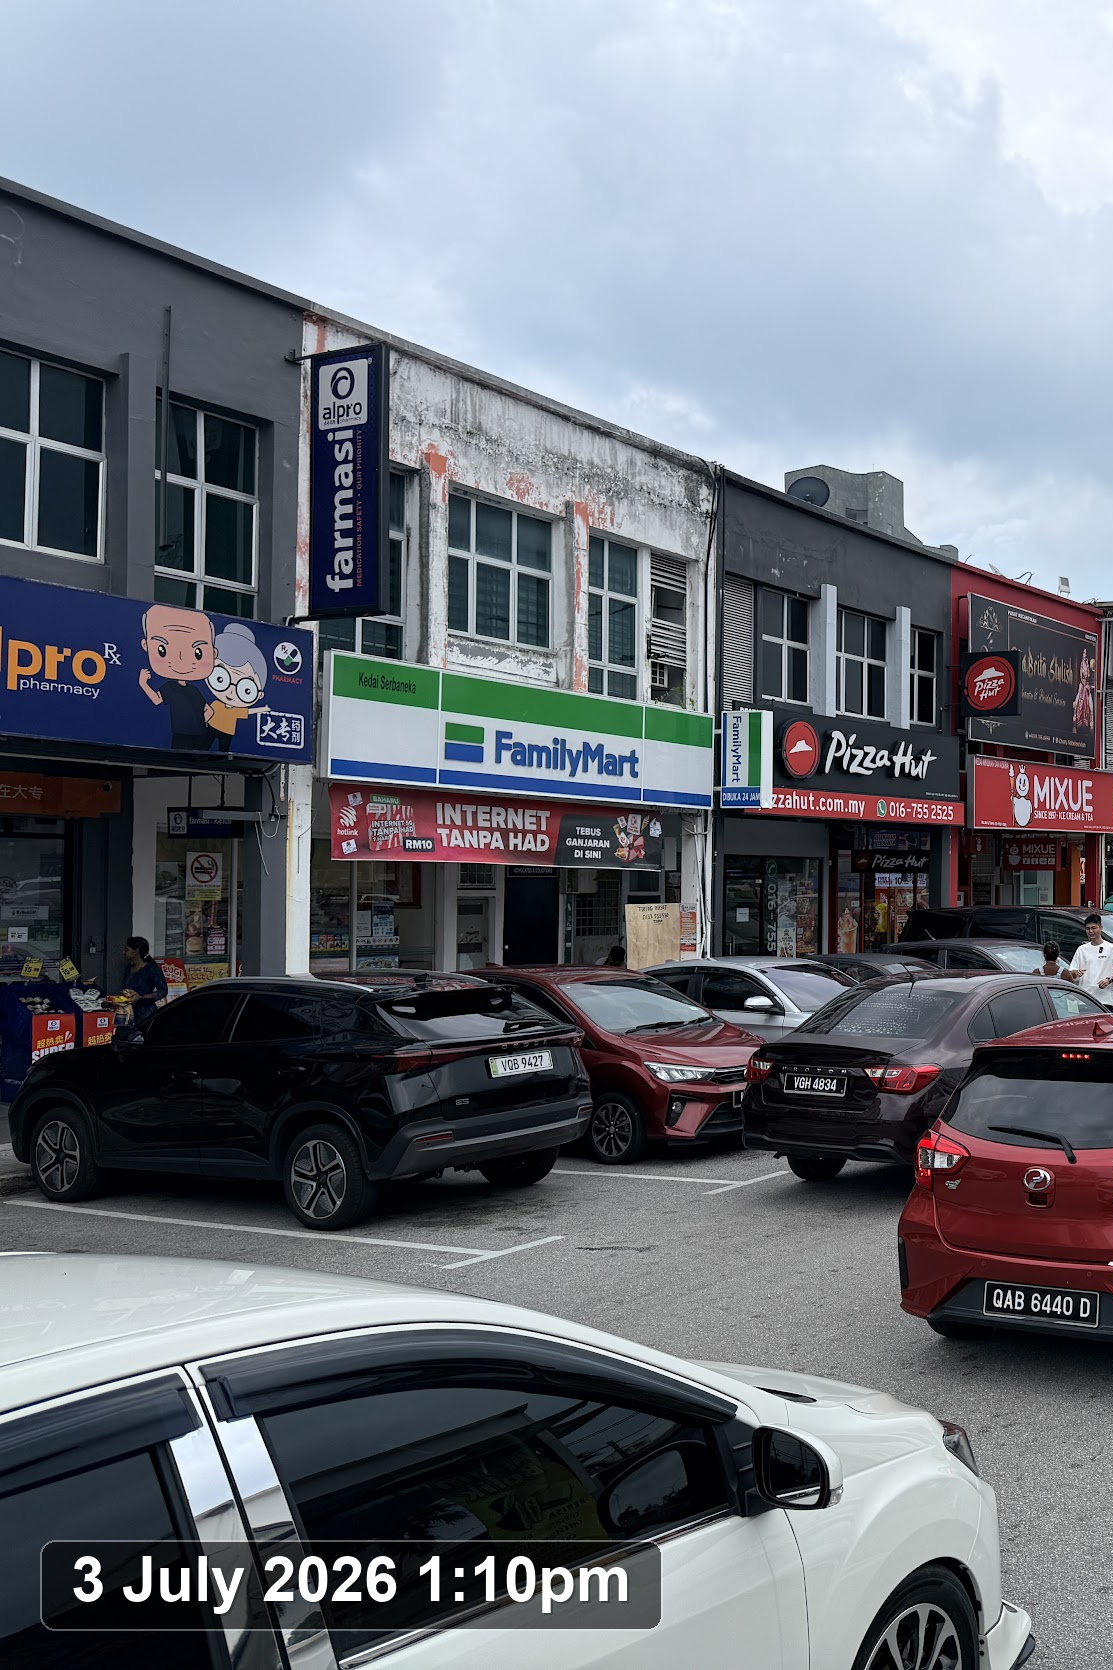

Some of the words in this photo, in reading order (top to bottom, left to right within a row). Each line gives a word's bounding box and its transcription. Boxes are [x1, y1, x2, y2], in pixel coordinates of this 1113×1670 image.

[323, 402, 362, 424] alpro
[326, 429, 354, 592] farmasi
[0, 626, 107, 690] pro
[19, 678, 101, 699] pharmacy
[358, 671, 379, 689] Kedai
[380, 675, 417, 694] Serbaneka
[974, 679, 1005, 696] Pizza
[980, 686, 1002, 701] Hut
[261, 717, 291, 742] 大专
[495, 730, 639, 778] FamilyMart
[732, 715, 742, 783] FamilyMart
[824, 730, 892, 776] Pizza
[892, 741, 938, 780] Hut
[373, 796, 399, 804] BAHARU
[723, 793, 741, 802] DIBUKA
[742, 793, 749, 802] 24
[1034, 775, 1093, 812] MIXUE
[436, 802, 551, 832] INTERNET
[889, 801, 929, 818] 016-755
[931, 805, 954, 820] 2525
[1034, 810, 1048, 820] SINCE
[1058, 811, 1066, 820] ICE
[1066, 812, 1081, 821] CREAM
[1085, 813, 1094, 821] TEA
[337, 828, 358, 836] hotlink
[372, 827, 399, 836] TANPA
[576, 826, 601, 836] TEBUS
[405, 840, 433, 849] RM10
[437, 828, 506, 851] TANPA
[508, 832, 550, 852] HAD
[565, 838, 610, 848] GANJARAN
[574, 849, 583, 858] DI
[585, 850, 601, 859] SINI
[1023, 844, 1056, 854] MIXUE
[872, 854, 904, 869] Pizza
[904, 854, 929, 868] Hut
[767, 883, 776, 951] 016-755
[501, 1058, 520, 1072] VQB
[521, 1055, 543, 1069] 9427
[782, 1066, 847, 1075] PROTON
[794, 1077, 812, 1090] VGH
[812, 1078, 837, 1091] 4834
